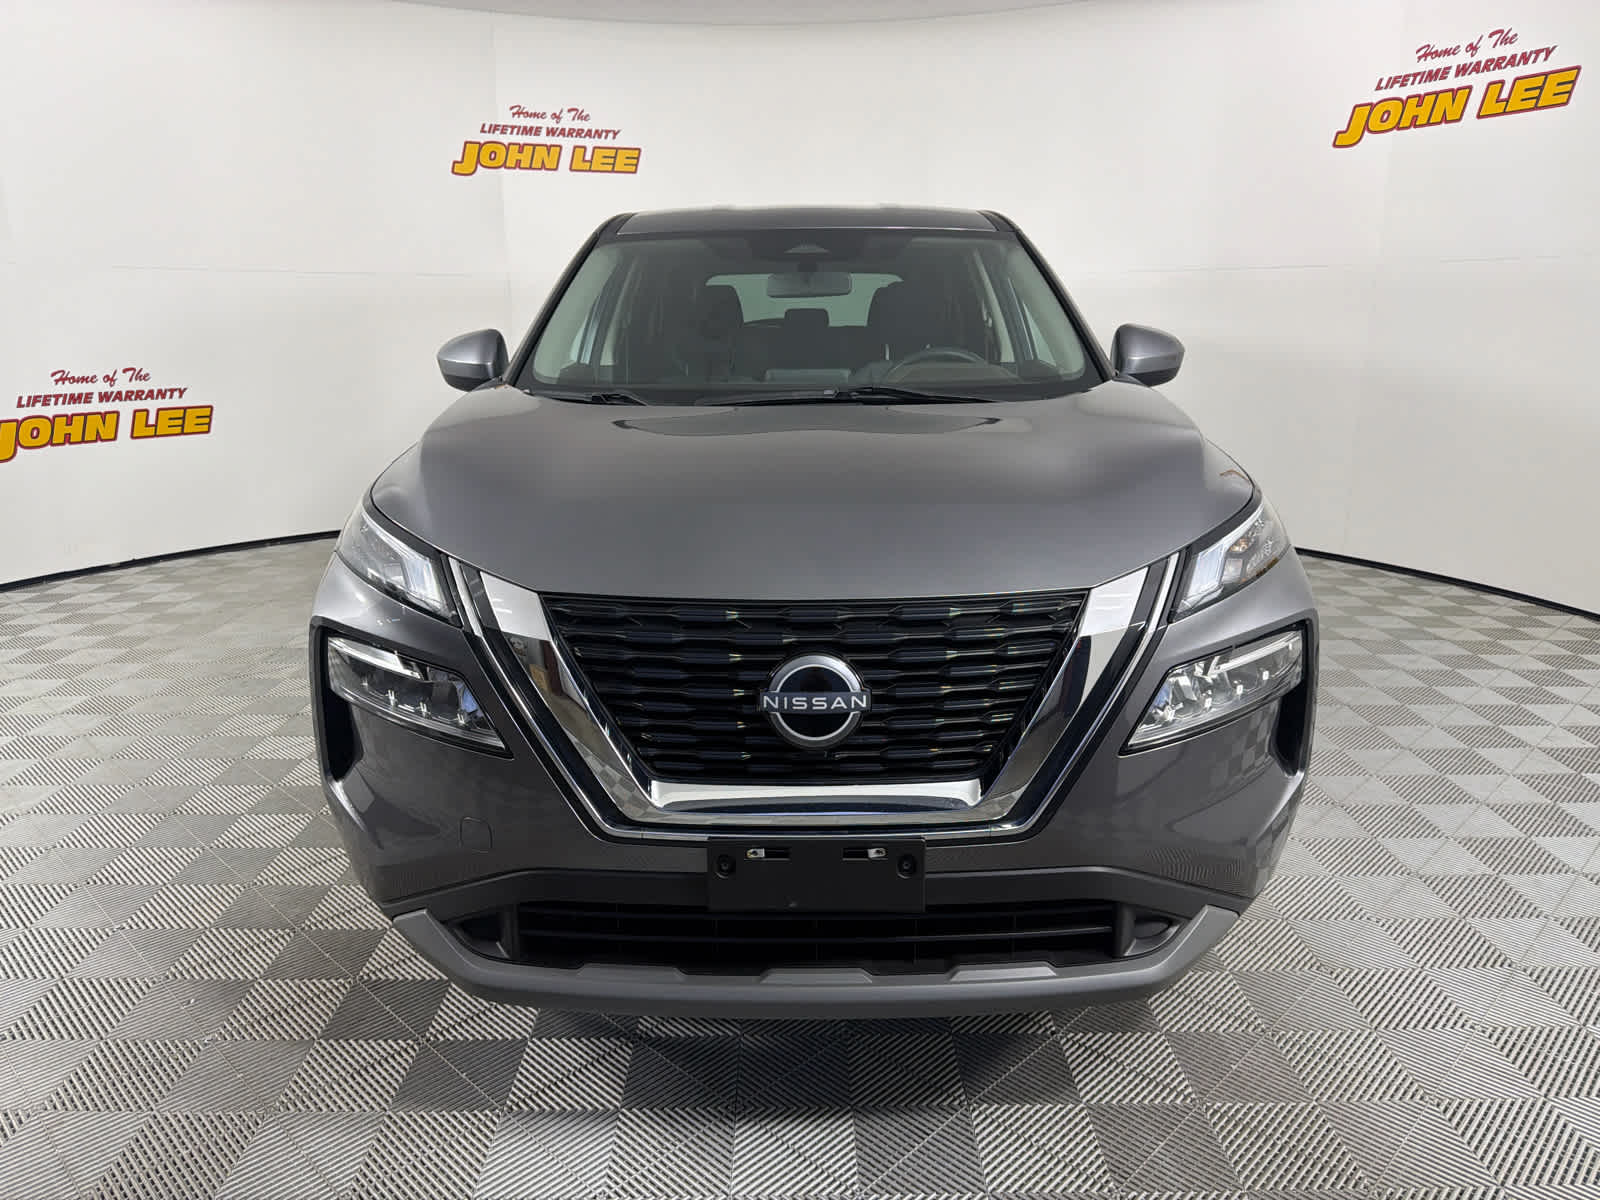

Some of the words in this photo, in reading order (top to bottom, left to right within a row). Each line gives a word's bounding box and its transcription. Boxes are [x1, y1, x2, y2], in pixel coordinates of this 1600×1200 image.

[1415, 43, 1461, 63] Home
[1465, 35, 1484, 57] of
[1488, 27, 1519, 49] The
[1374, 65, 1451, 91] LIFETIME
[1454, 45, 1558, 78] WARRANTY
[509, 104, 547, 119] Home
[550, 108, 564, 124] of
[567, 107, 591, 122] The
[1332, 85, 1473, 148] JOHN
[1476, 65, 1582, 119] LEE
[479, 123, 542, 137] LIFETIME
[545, 126, 620, 140] WARRANTY
[451, 141, 562, 176] JOHN
[569, 145, 641, 174] LEE
[50, 369, 98, 386] Home
[102, 369, 117, 387] of
[122, 367, 151, 383] The
[16, 392, 94, 408] LIFETIME
[98, 387, 188, 403] WARRANTY
[130, 405, 213, 439] LEE
[763, 695, 867, 710] NISSAN
